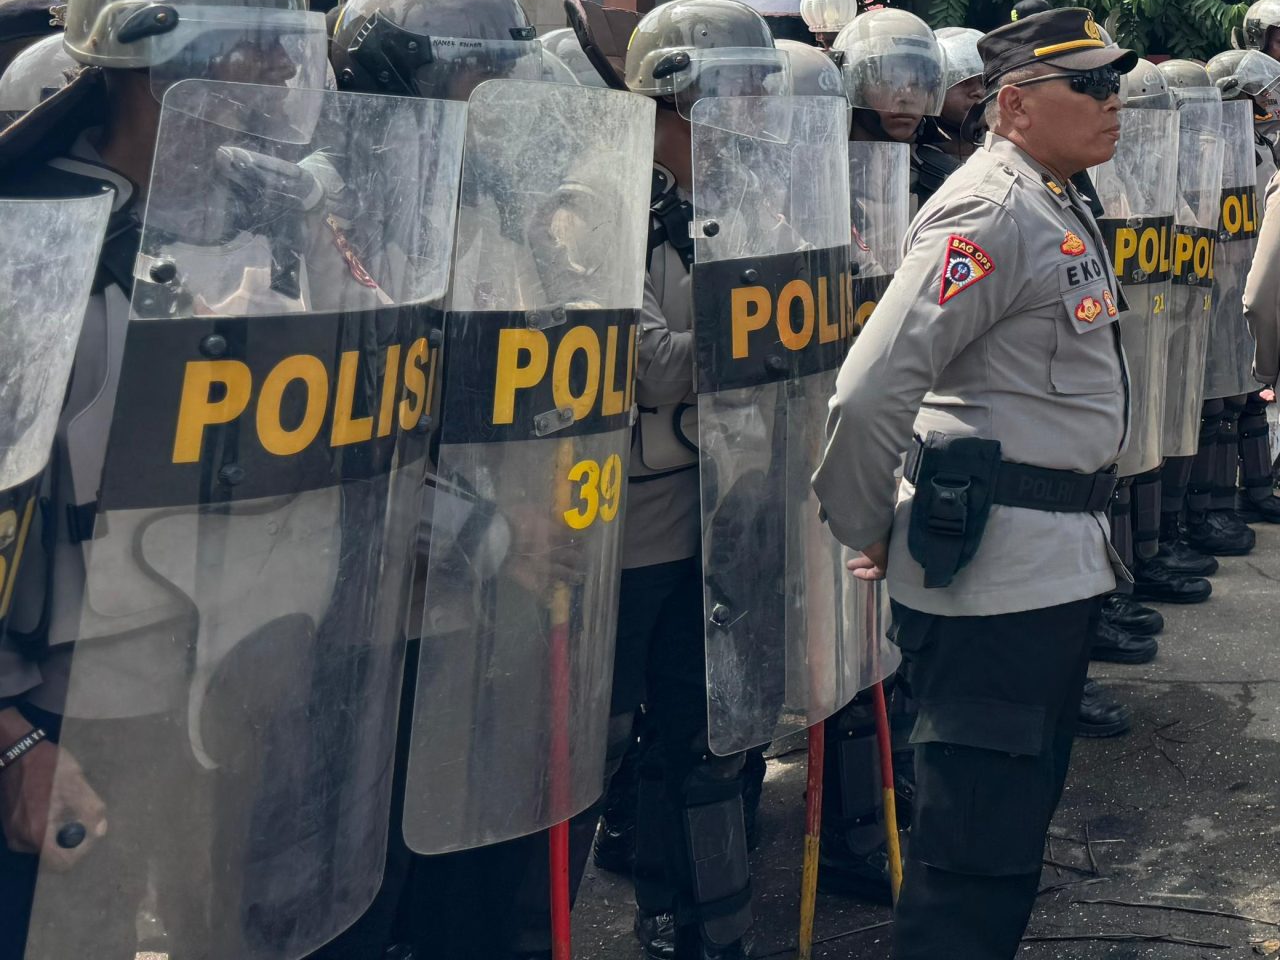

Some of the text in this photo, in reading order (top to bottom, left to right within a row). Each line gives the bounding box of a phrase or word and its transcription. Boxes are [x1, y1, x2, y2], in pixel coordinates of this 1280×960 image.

[1223, 192, 1257, 234] OLI
[952, 239, 992, 270] BAG OPS
[1067, 258, 1101, 286] EKO
[172, 337, 438, 463] POLISI
[564, 454, 622, 529] 39
